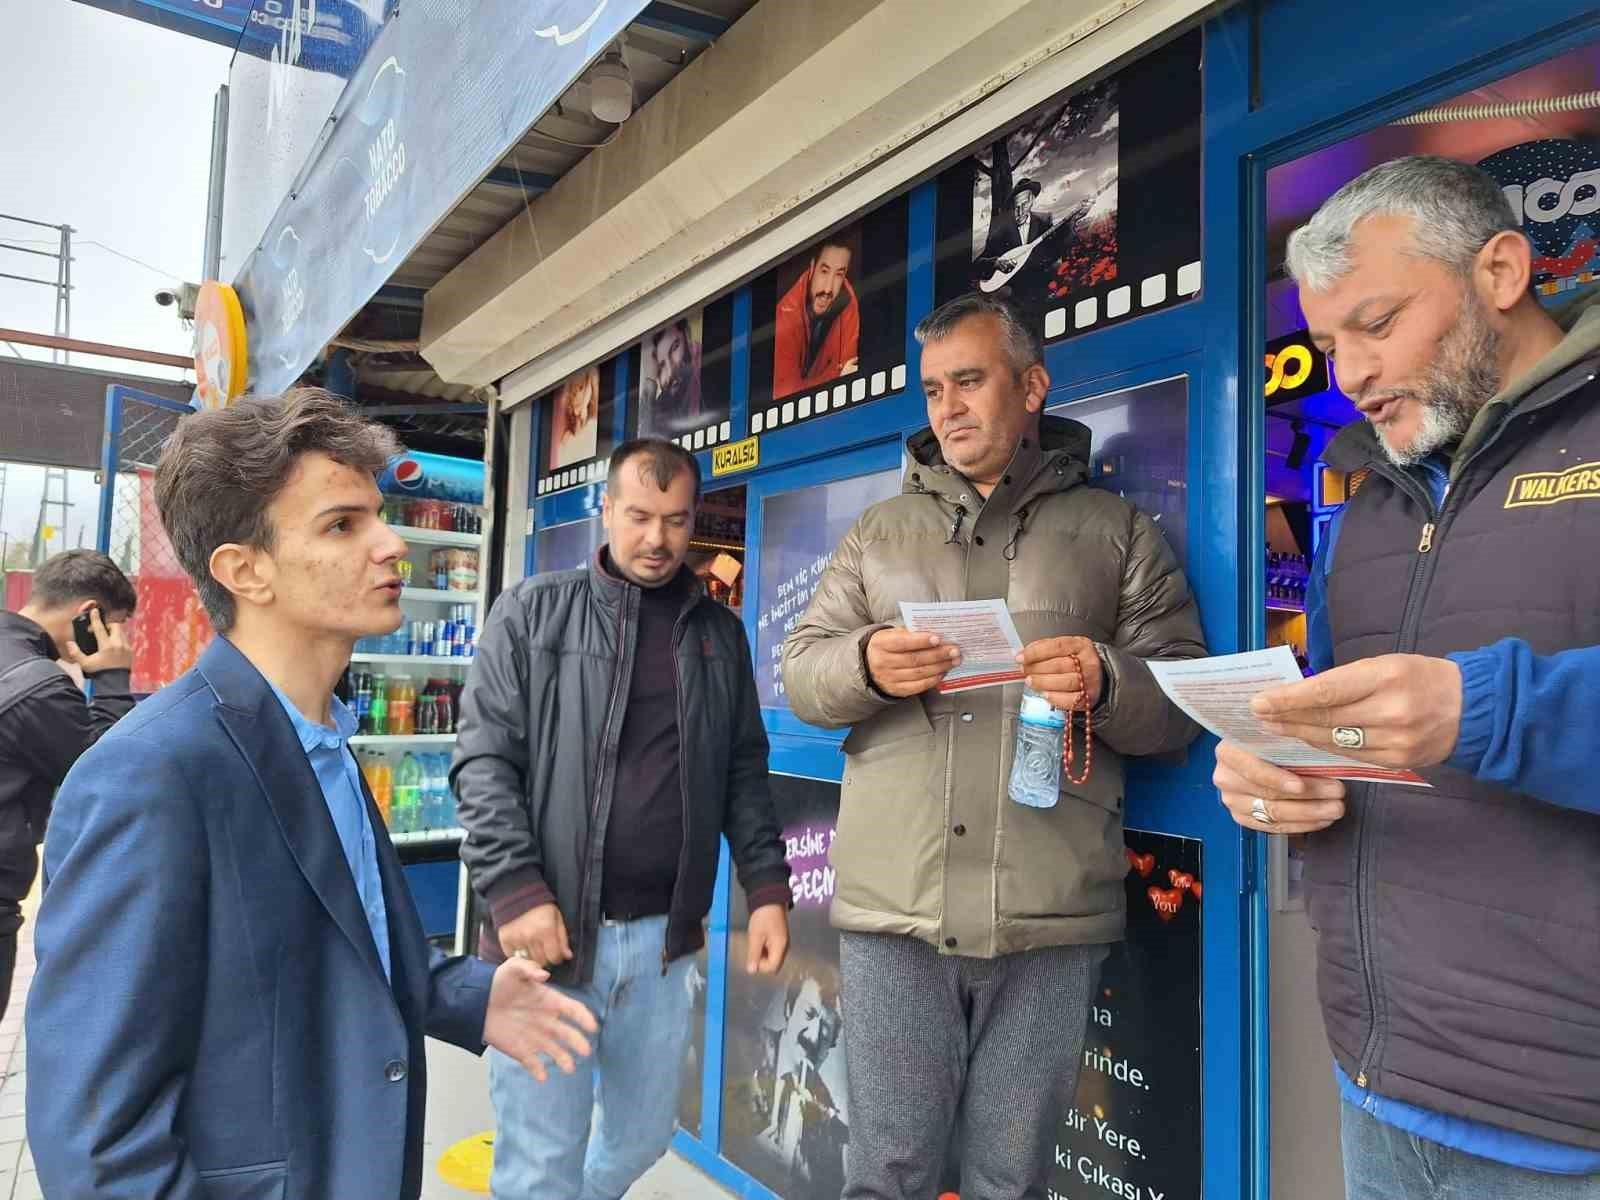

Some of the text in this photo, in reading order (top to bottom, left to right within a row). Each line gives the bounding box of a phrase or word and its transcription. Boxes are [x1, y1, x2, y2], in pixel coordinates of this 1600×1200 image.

[1519, 469, 1600, 500] WALKERS
[758, 612, 769, 632] NE
[785, 827, 826, 860] ERSİNE
[1085, 1047, 1150, 1091] rinde.
[1094, 1116, 1147, 1161] Yere.
